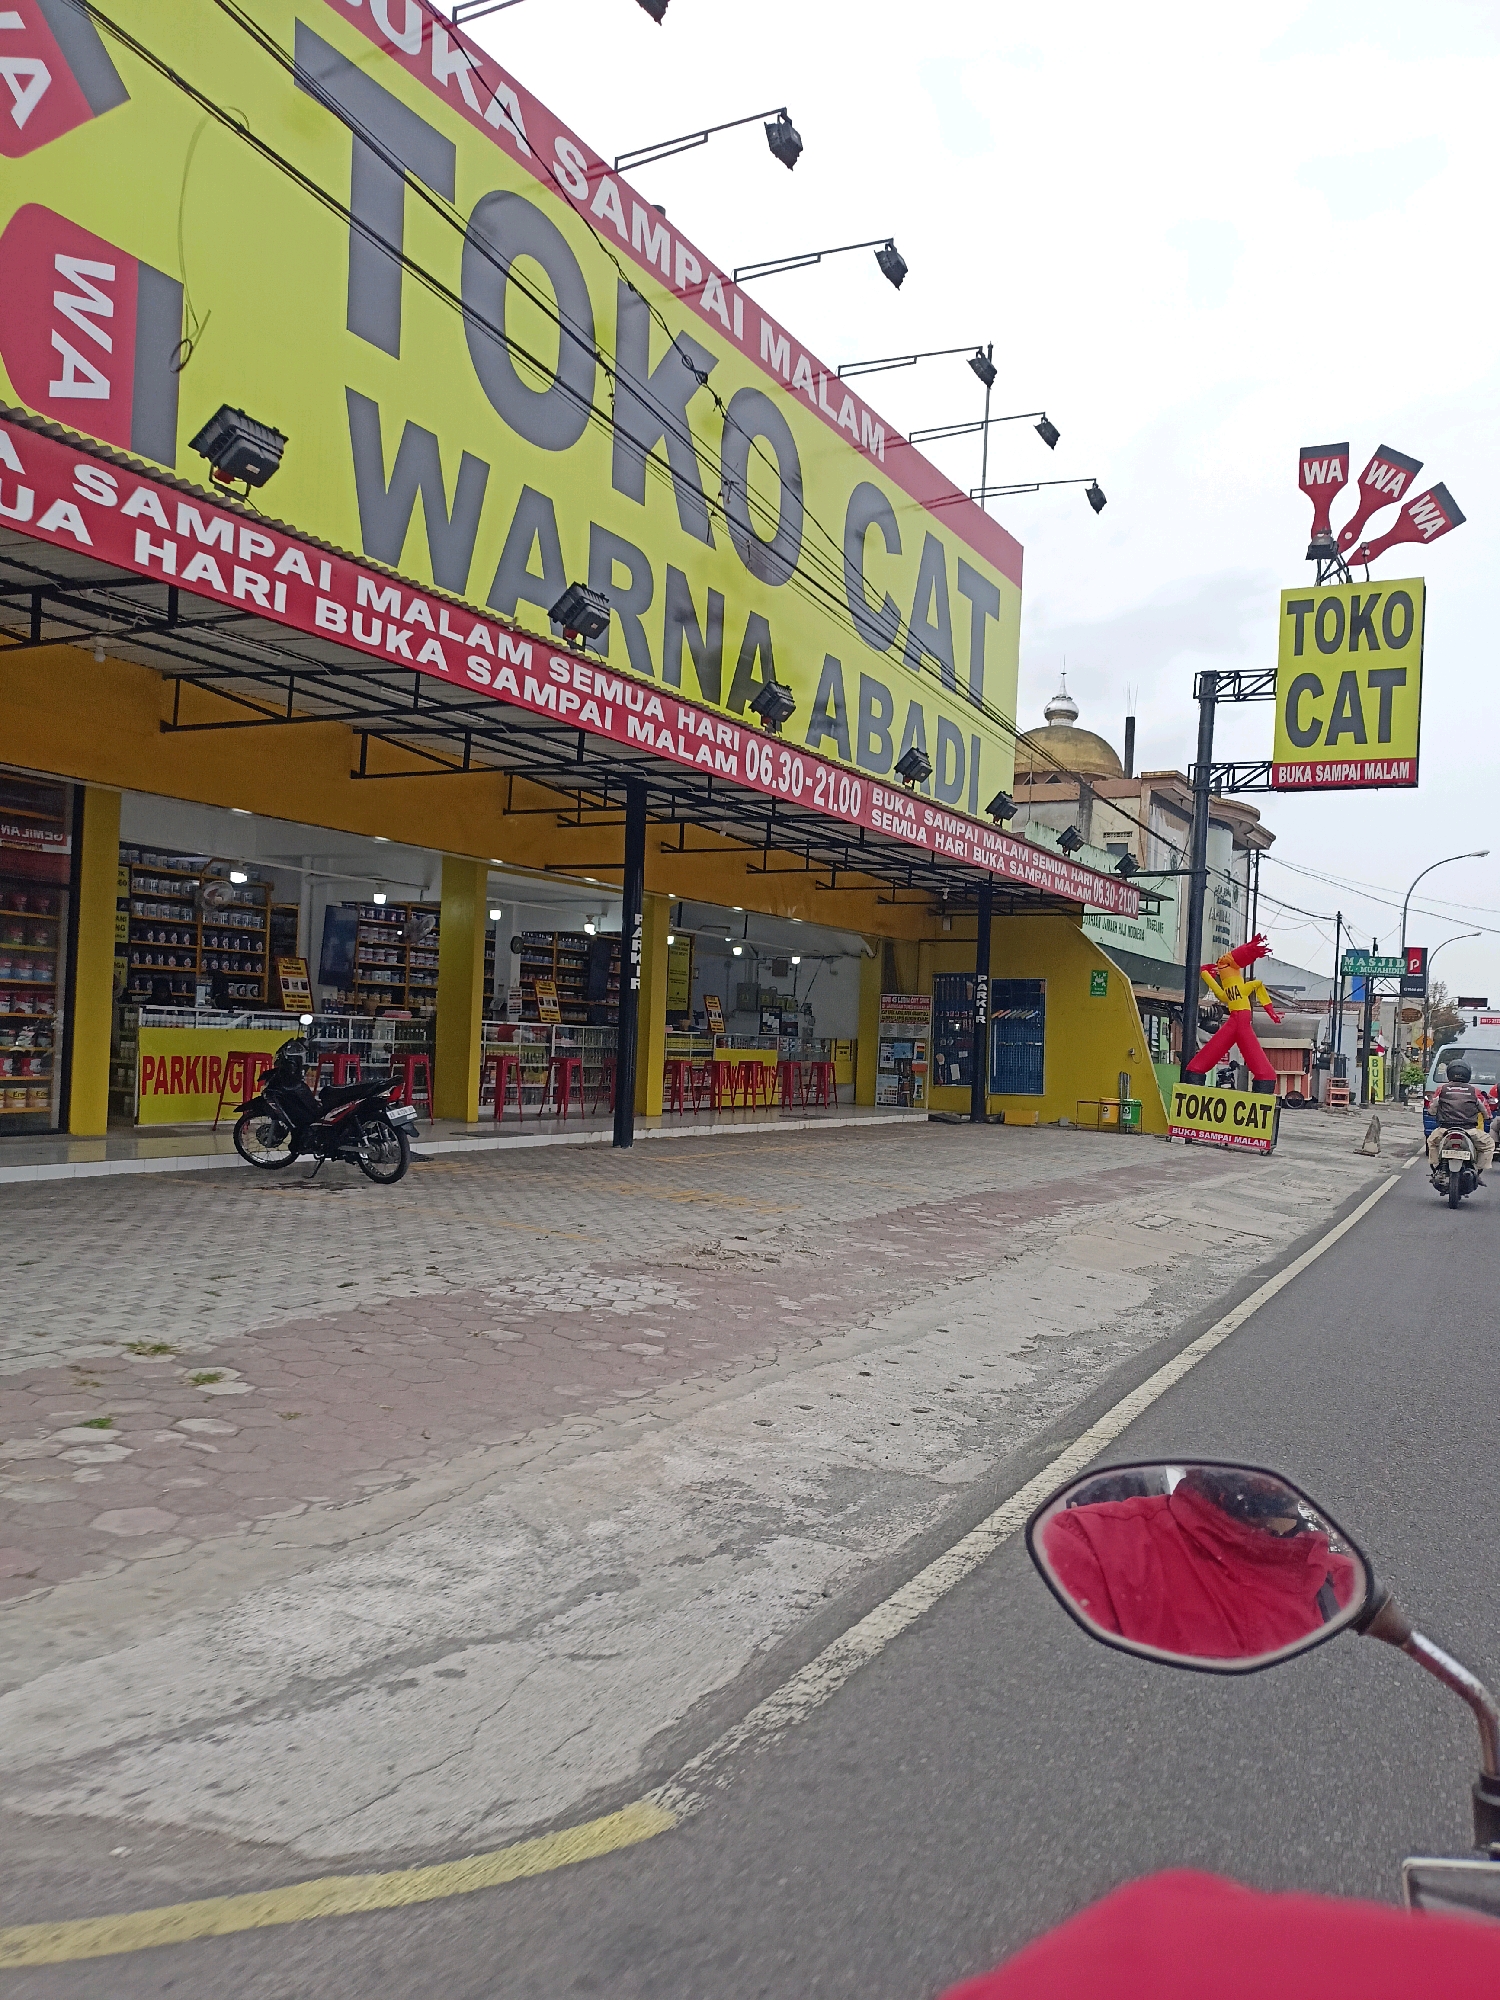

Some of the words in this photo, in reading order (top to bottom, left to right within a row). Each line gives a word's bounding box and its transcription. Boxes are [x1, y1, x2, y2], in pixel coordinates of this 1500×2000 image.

[0, 11, 52, 130] A
[345, 0, 532, 158] UKA
[552, 136, 744, 341] SAMPAI
[760, 317, 885, 463] MALAM
[49, 253, 116, 400] WA
[294, 17, 804, 586] TOKO
[843, 481, 1000, 709] CAT
[1303, 458, 1344, 486] WA
[1367, 459, 1407, 499] WA
[1408, 494, 1446, 540] WA
[72, 464, 332, 592] SAMPAI
[357, 576, 533, 670] MALAM
[549, 652, 665, 723] SEMUA
[677, 707, 740, 752] HARI
[345, 385, 783, 732] WARNA
[805, 653, 981, 817] ABADI
[1286, 590, 1415, 657] TOKO
[134, 528, 287, 614] HARI
[315, 596, 449, 672] BUKA
[466, 655, 612, 731] SAMPAI
[627, 715, 738, 776] MALAM
[1285, 667, 1407, 748] CAT
[1278, 765, 1312, 784] BUKA
[1315, 763, 1361, 782] SAMPAI
[1364, 761, 1410, 780] MALAM
[871, 811, 927, 844] SEMUA
[934, 832, 968, 857] HARI
[973, 849, 1005, 872] BUKA
[1009, 860, 1051, 887] SAMPAI
[1054, 876, 1092, 901] MALAM
[872, 788, 915, 820] BUKA
[923, 810, 979, 843] SAMPAI
[983, 832, 1029, 863] MALAM
[1032, 852, 1067, 878] SEMUA
[1070, 868, 1093, 887] HARI
[1343, 956, 1406, 968] MASJID
[1360, 966, 1406, 975] MUJAHIDIN
[975, 974, 988, 1024] PARKIR
[1225, 984, 1243, 1002] WA
[142, 1055, 222, 1096] PARKIR
[1172, 1127, 1197, 1137] BUKA
[1198, 1131, 1232, 1142] SAMPAI
[1234, 1137, 1267, 1148] MALAM
[1175, 1092, 1227, 1124] TOKO
[1233, 1100, 1273, 1130] CAT
